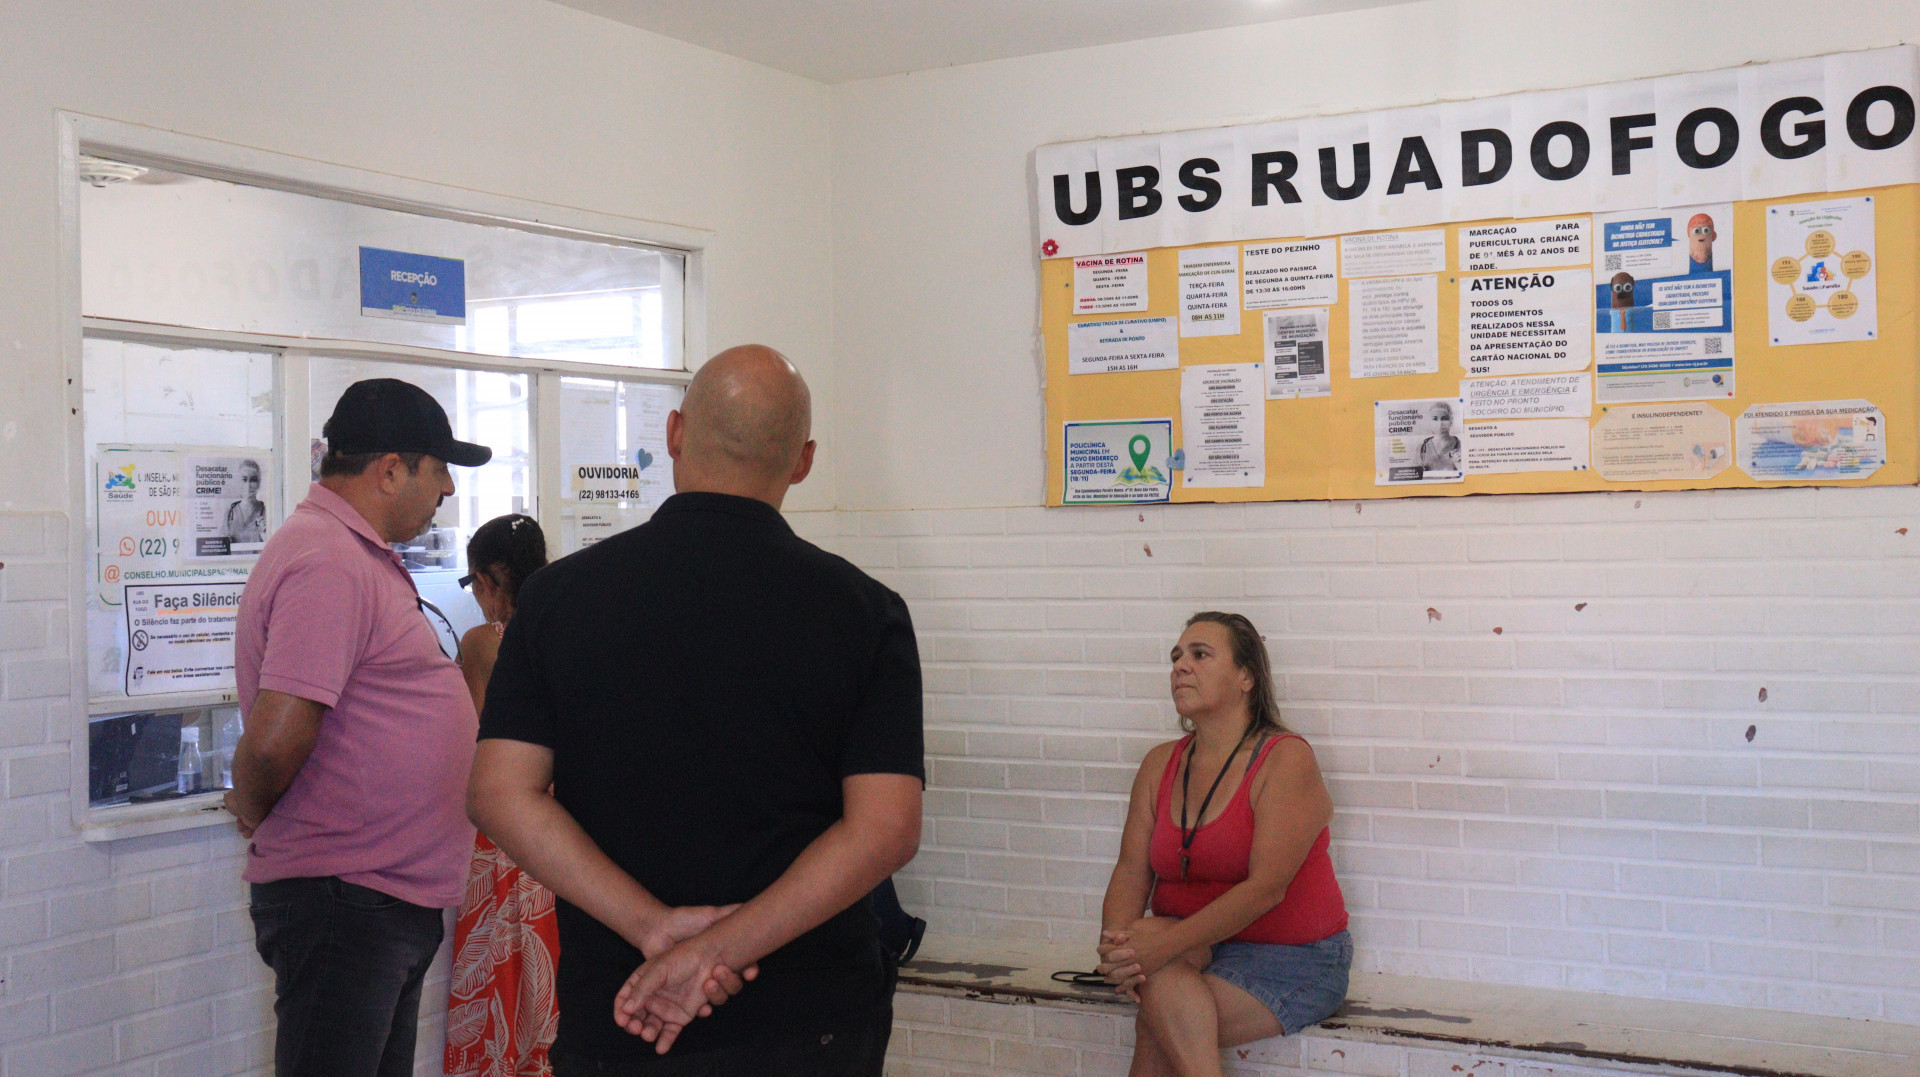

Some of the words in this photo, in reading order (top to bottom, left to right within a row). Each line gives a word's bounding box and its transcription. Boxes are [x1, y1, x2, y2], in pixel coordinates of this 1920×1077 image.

[1053, 157, 1222, 226] UBS
[1469, 227, 1517, 236] MARCAÇÃO
[1555, 222, 1580, 230] PARA
[1469, 237, 1536, 248] PUERICULTURA
[1540, 234, 1580, 243] CRIANÇA
[1245, 248, 1270, 256] TESTE
[1284, 244, 1320, 252] PEZINHO
[1076, 259, 1103, 267] VACINA
[1116, 256, 1144, 264] ROTINA
[1470, 262, 1498, 270] IDADE.
[1245, 268, 1278, 276] REALIZADO
[390, 270, 438, 287] RECEPÇÃO
[1290, 273, 1334, 282] QUINTA-FEIRA
[1470, 273, 1555, 292] ATENÇÃO
[1189, 281, 1225, 290] TERÇA-FEIRA
[1186, 292, 1228, 300] QUARTA-FEIRA
[1187, 302, 1228, 310] QUINTA-FEIRA
[1470, 310, 1544, 318] PROCEDIMENTOS
[1470, 322, 1524, 330] REALIZADOS
[1470, 332, 1508, 340] UNIDADE
[1510, 328, 1566, 338] NECESSITAM
[1484, 340, 1552, 350] APRESENTAÇÃO
[1082, 354, 1124, 362] SEGUNDA-FEIRA
[1470, 354, 1504, 362] CARTÃO
[1508, 352, 1552, 360] NACIONAL
[1511, 377, 1566, 386] ATENDIMENTO
[1470, 388, 1509, 397] URGÊNCIA
[1518, 386, 1570, 394] EMERGÊNCIA
[1839, 406, 1877, 414] MEDICAÇÃO?
[578, 467, 639, 479] OUVIDORIA
[149, 488, 157, 496] DE
[158, 484, 171, 496] SÃO
[579, 490, 594, 501] (22)
[140, 538, 167, 558] (22)
[154, 594, 188, 611] Faça
[181, 617, 197, 626] parte
